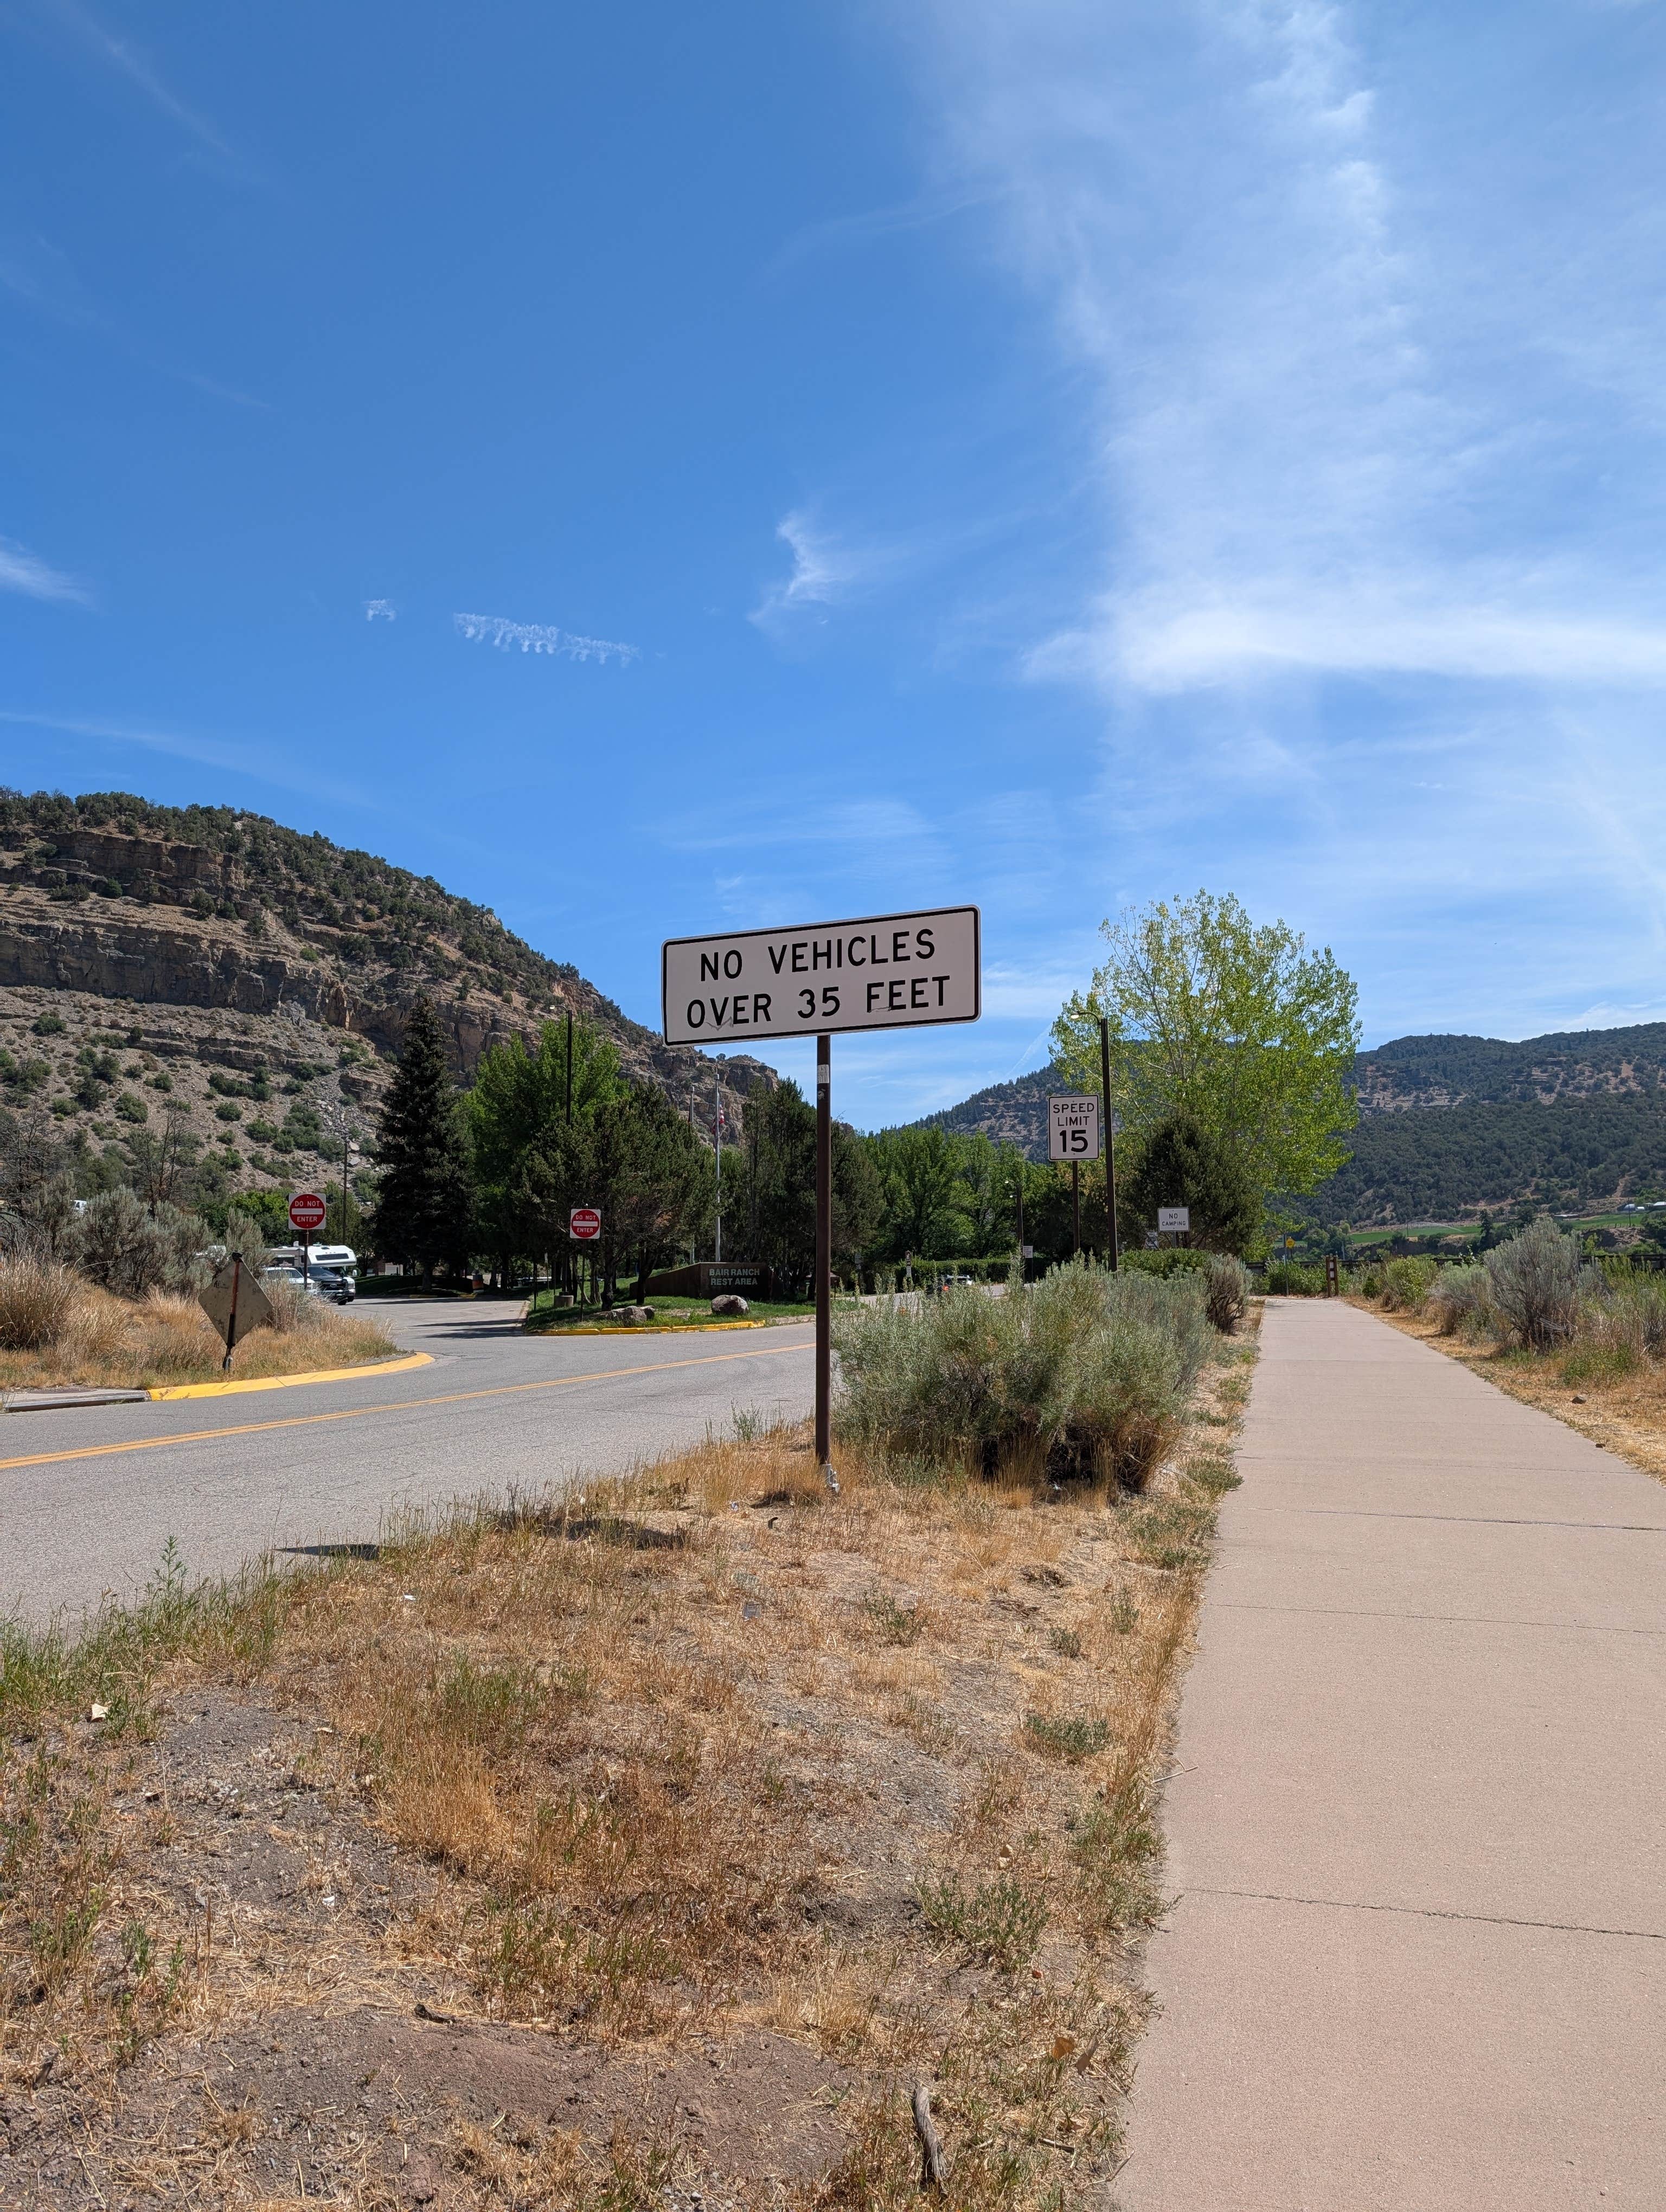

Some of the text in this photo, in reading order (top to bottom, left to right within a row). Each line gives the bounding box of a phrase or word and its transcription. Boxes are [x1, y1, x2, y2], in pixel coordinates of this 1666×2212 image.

[701, 929, 935, 982] NO VEHICLES
[687, 975, 950, 1028] OVER 35 FEET
[1053, 1103, 1094, 1114] SPEED
[1058, 1116, 1090, 1126] LIMIT
[1059, 1129, 1088, 1153] 15
